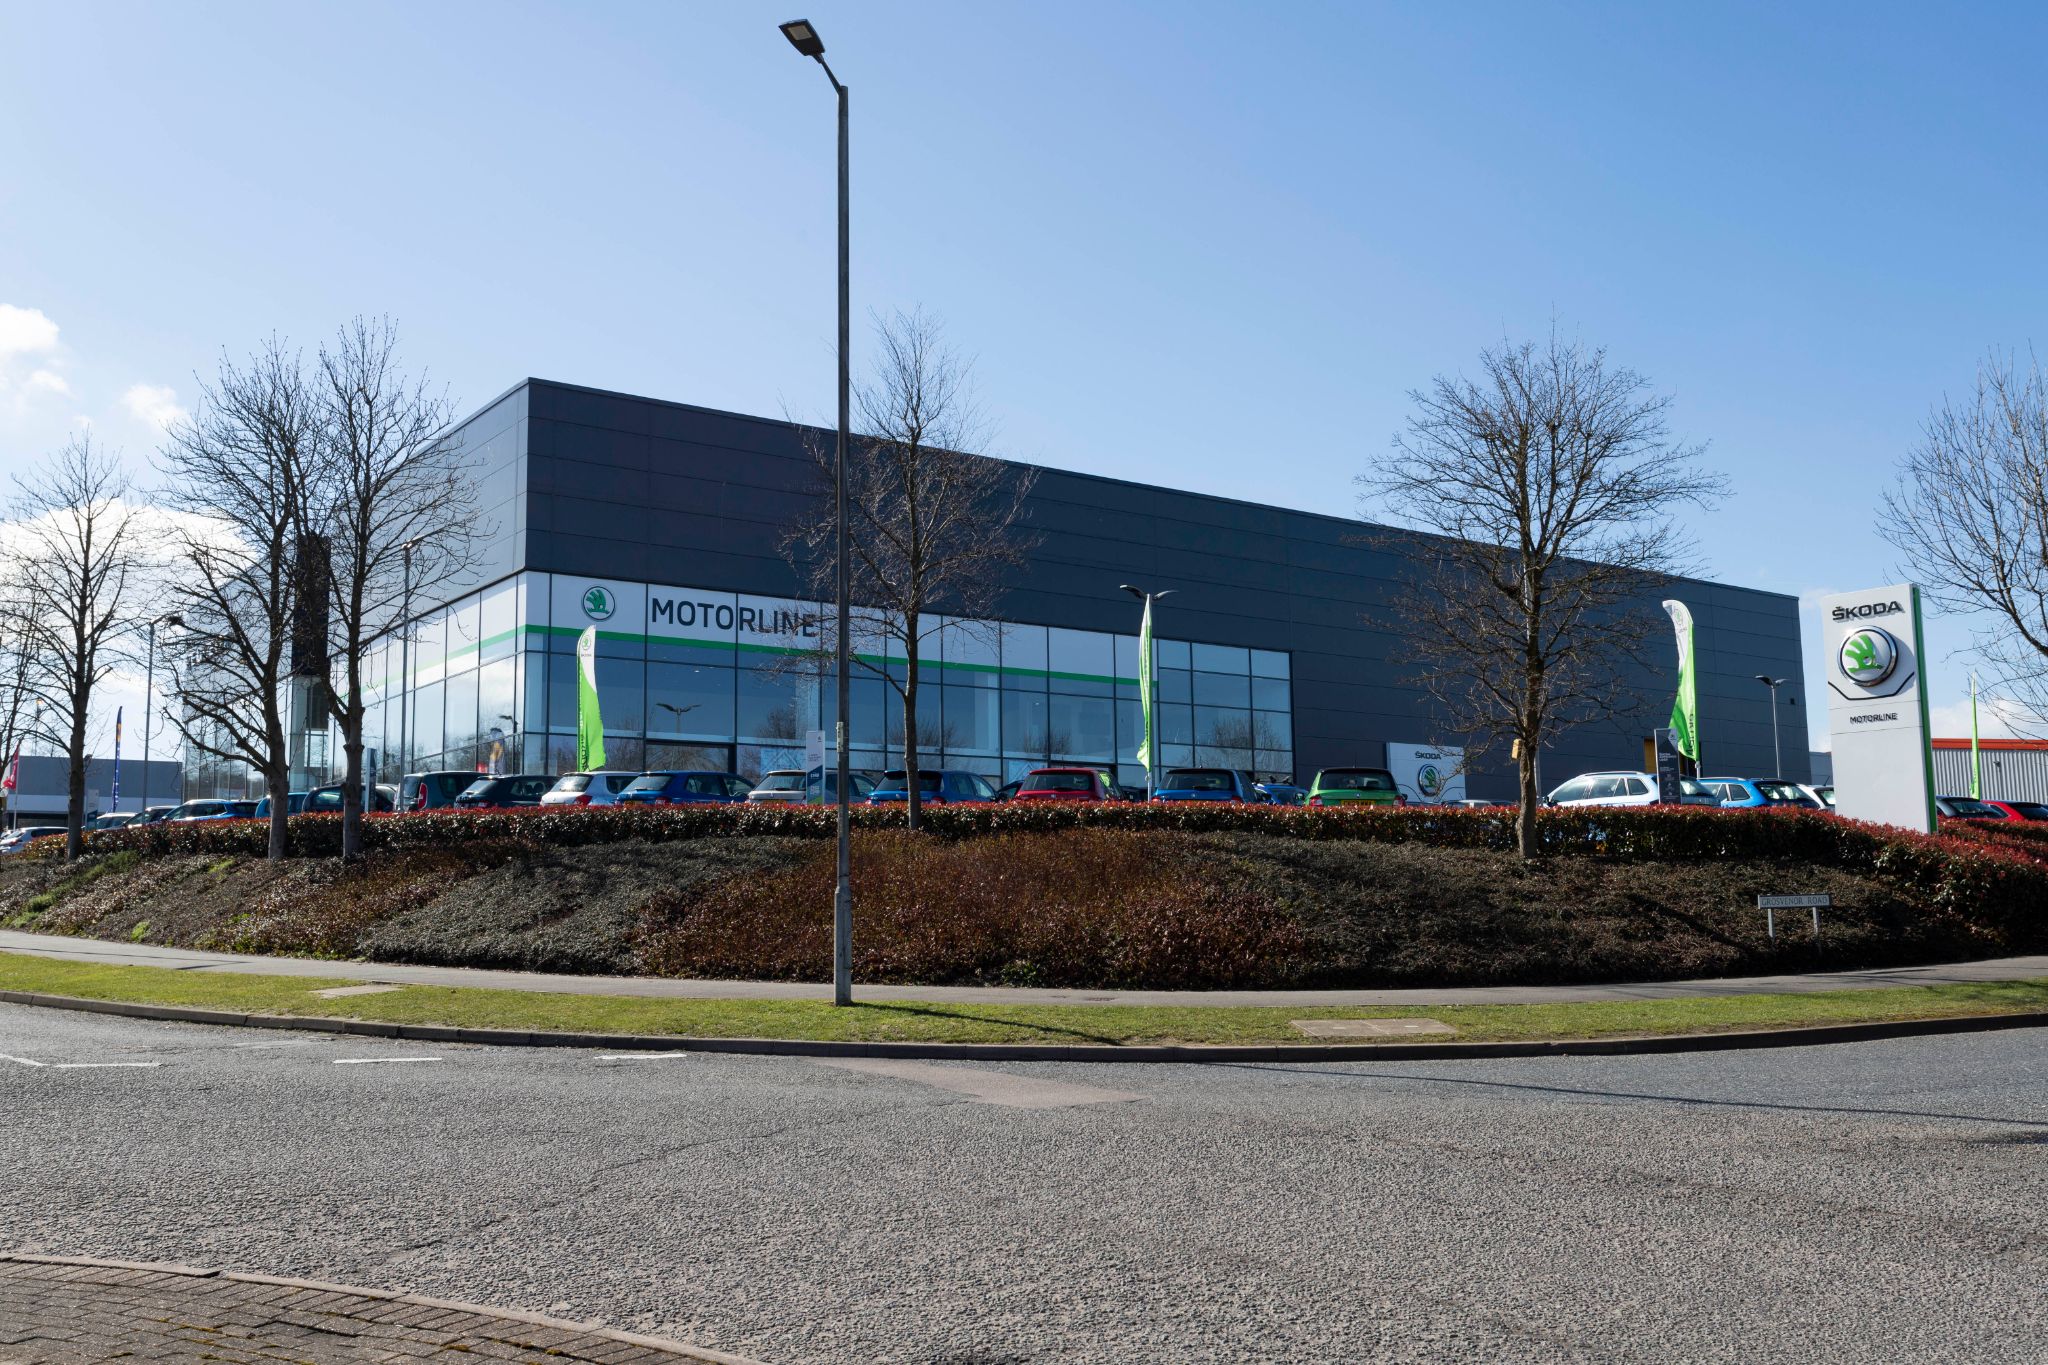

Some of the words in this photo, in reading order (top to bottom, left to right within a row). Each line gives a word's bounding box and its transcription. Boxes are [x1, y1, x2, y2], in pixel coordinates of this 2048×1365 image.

[651, 597, 817, 637] MOTORLINE
[1832, 600, 1902, 621] ŠKODA
[1849, 713, 1898, 724] MOTORLINE
[1761, 897, 1803, 906] GROSVENOR
[1807, 896, 1827, 904] ROAD
